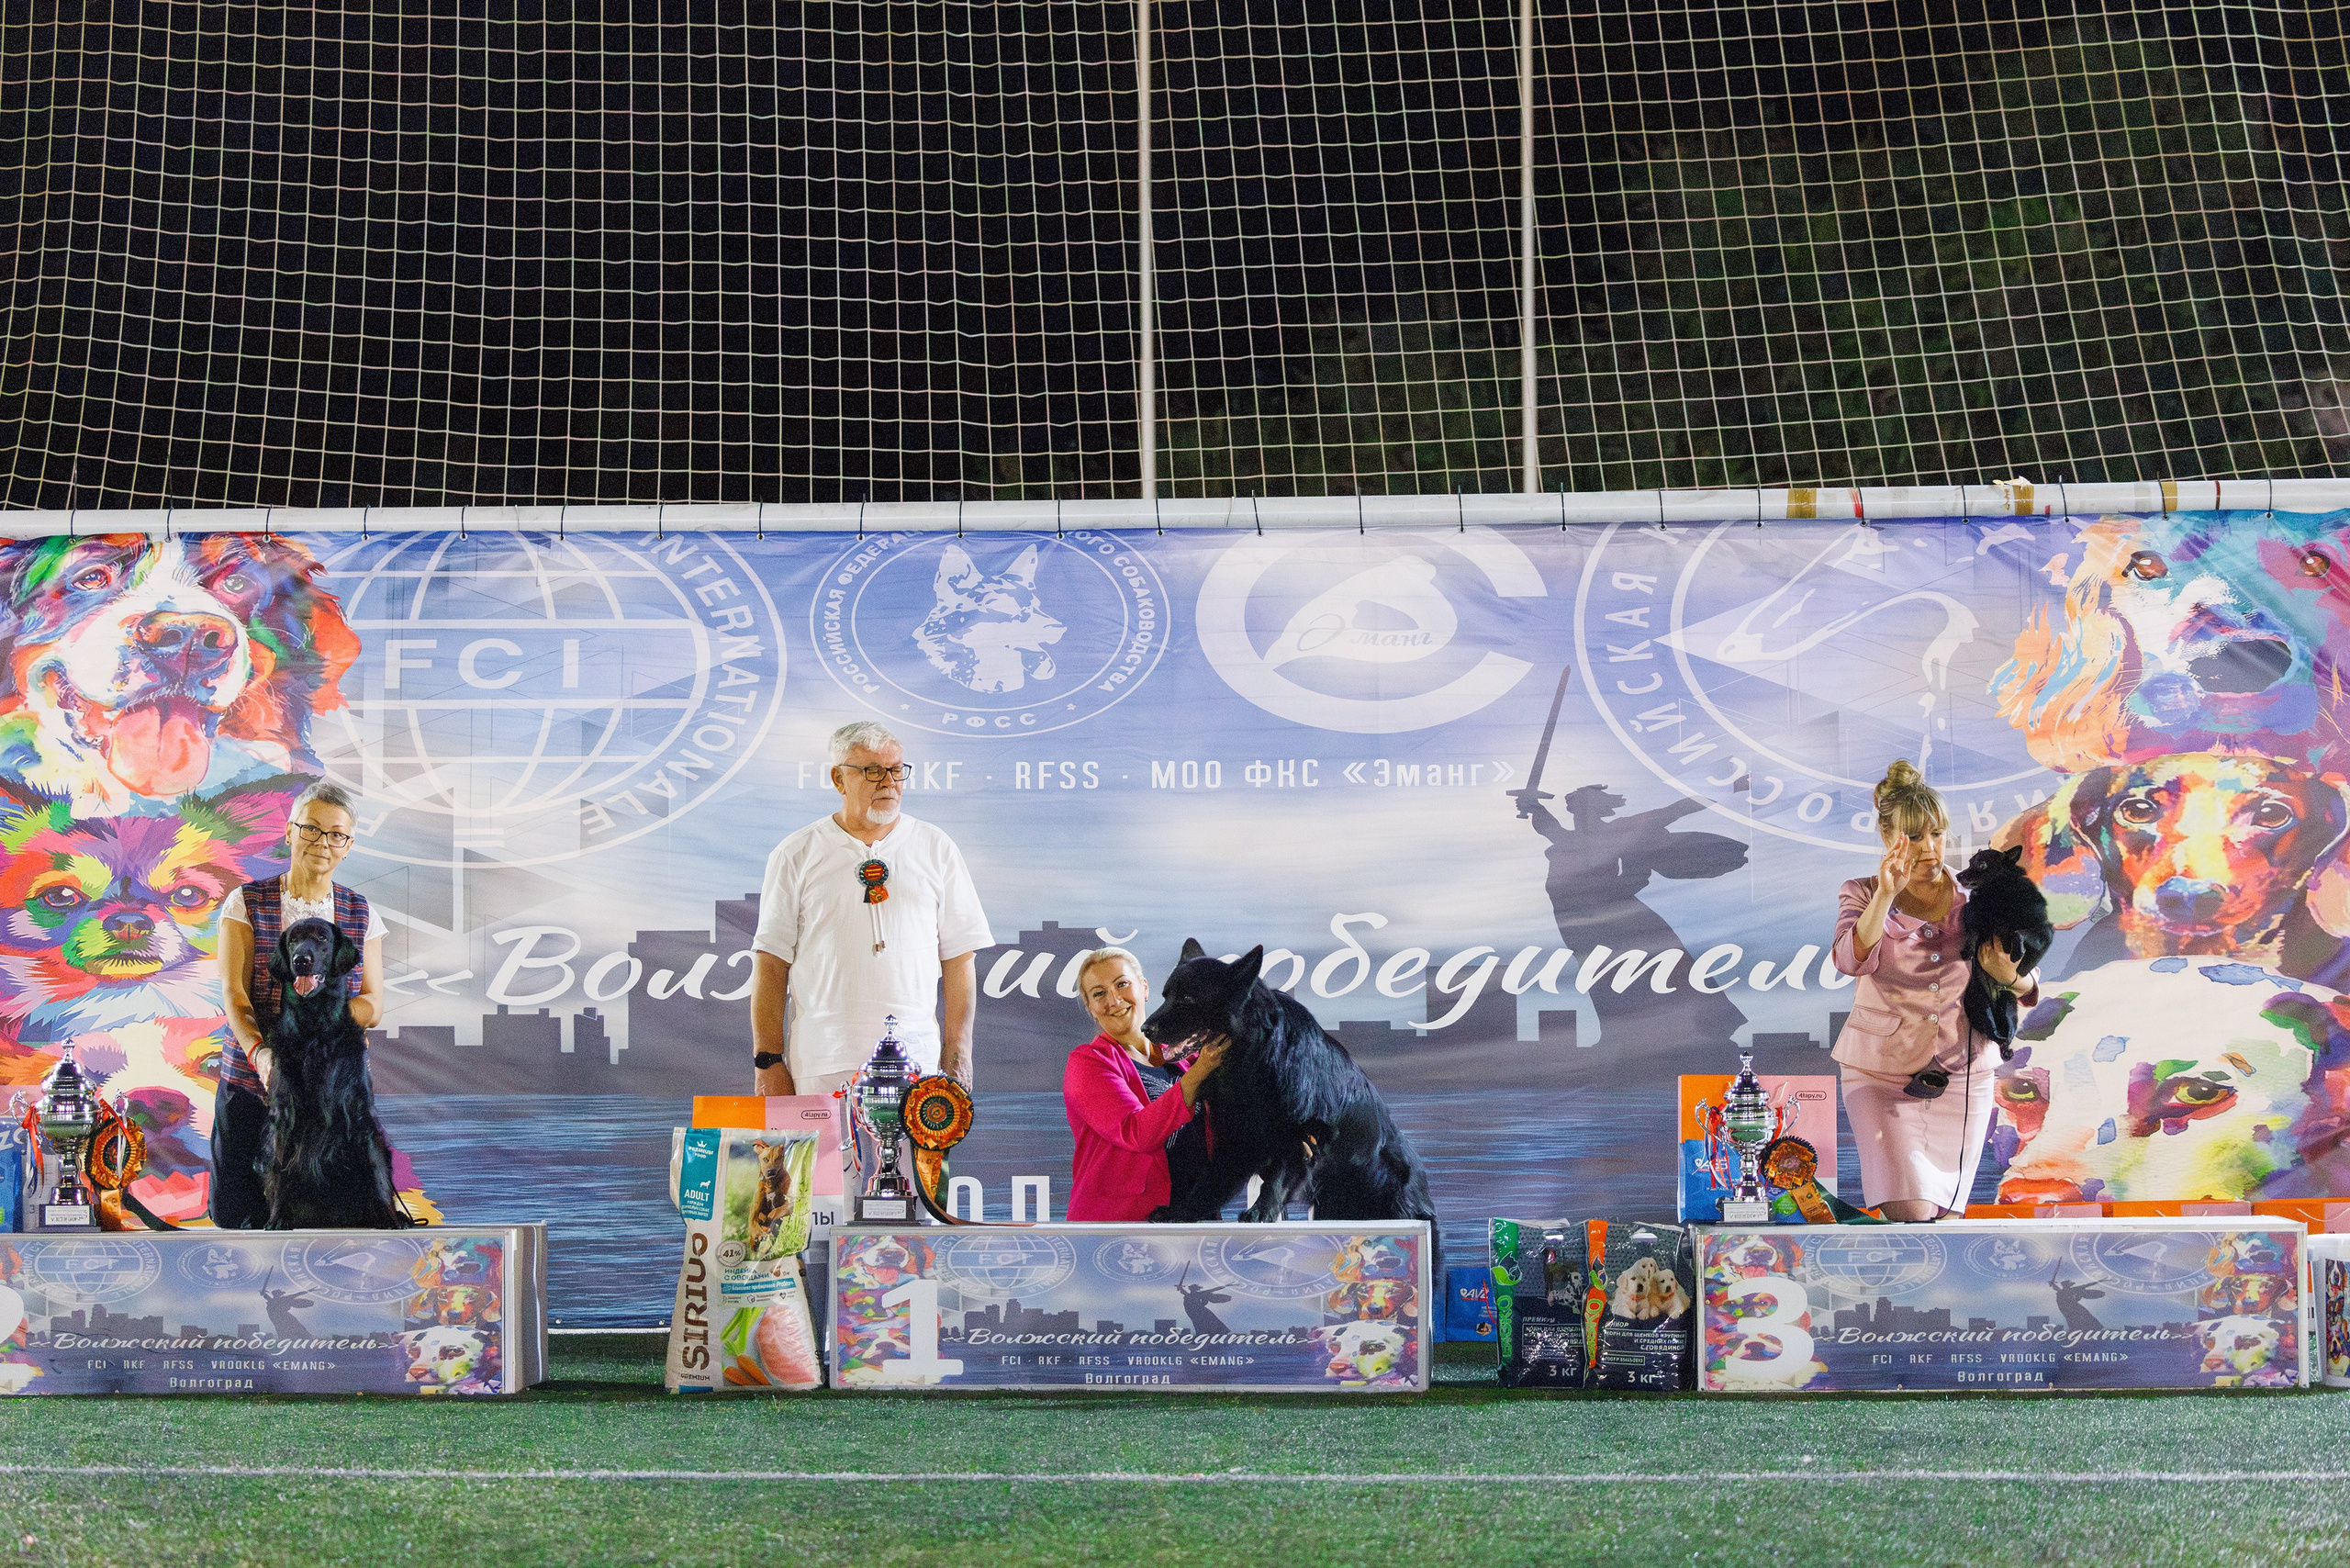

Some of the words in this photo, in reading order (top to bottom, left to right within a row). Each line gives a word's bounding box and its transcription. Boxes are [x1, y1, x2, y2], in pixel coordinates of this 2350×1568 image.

[385, 638, 580, 689] FCI
[941, 712, 1036, 729] РФСС
[798, 761, 834, 790] FC
[1015, 761, 1100, 790] RFSS
[1245, 758, 1320, 788] ФКС
[1342, 758, 1516, 787] «Эманг»
[684, 1188, 711, 1202] ADULT
[881, 1279, 964, 1375] 1
[1725, 1276, 1815, 1377] 3
[1002, 1355, 1022, 1365] FCI
[1079, 1355, 1110, 1366] RFSS
[1873, 1354, 1892, 1364] FCI
[1951, 1353, 1983, 1363] RFSS
[87, 1360, 107, 1370] FCI
[1549, 1365, 1558, 1377] 3
[170, 1377, 253, 1389] Волгоград
[1085, 1372, 1170, 1384] Волгоград
[1628, 1371, 1636, 1383] 3
[1957, 1371, 2043, 1383] Волгоград
